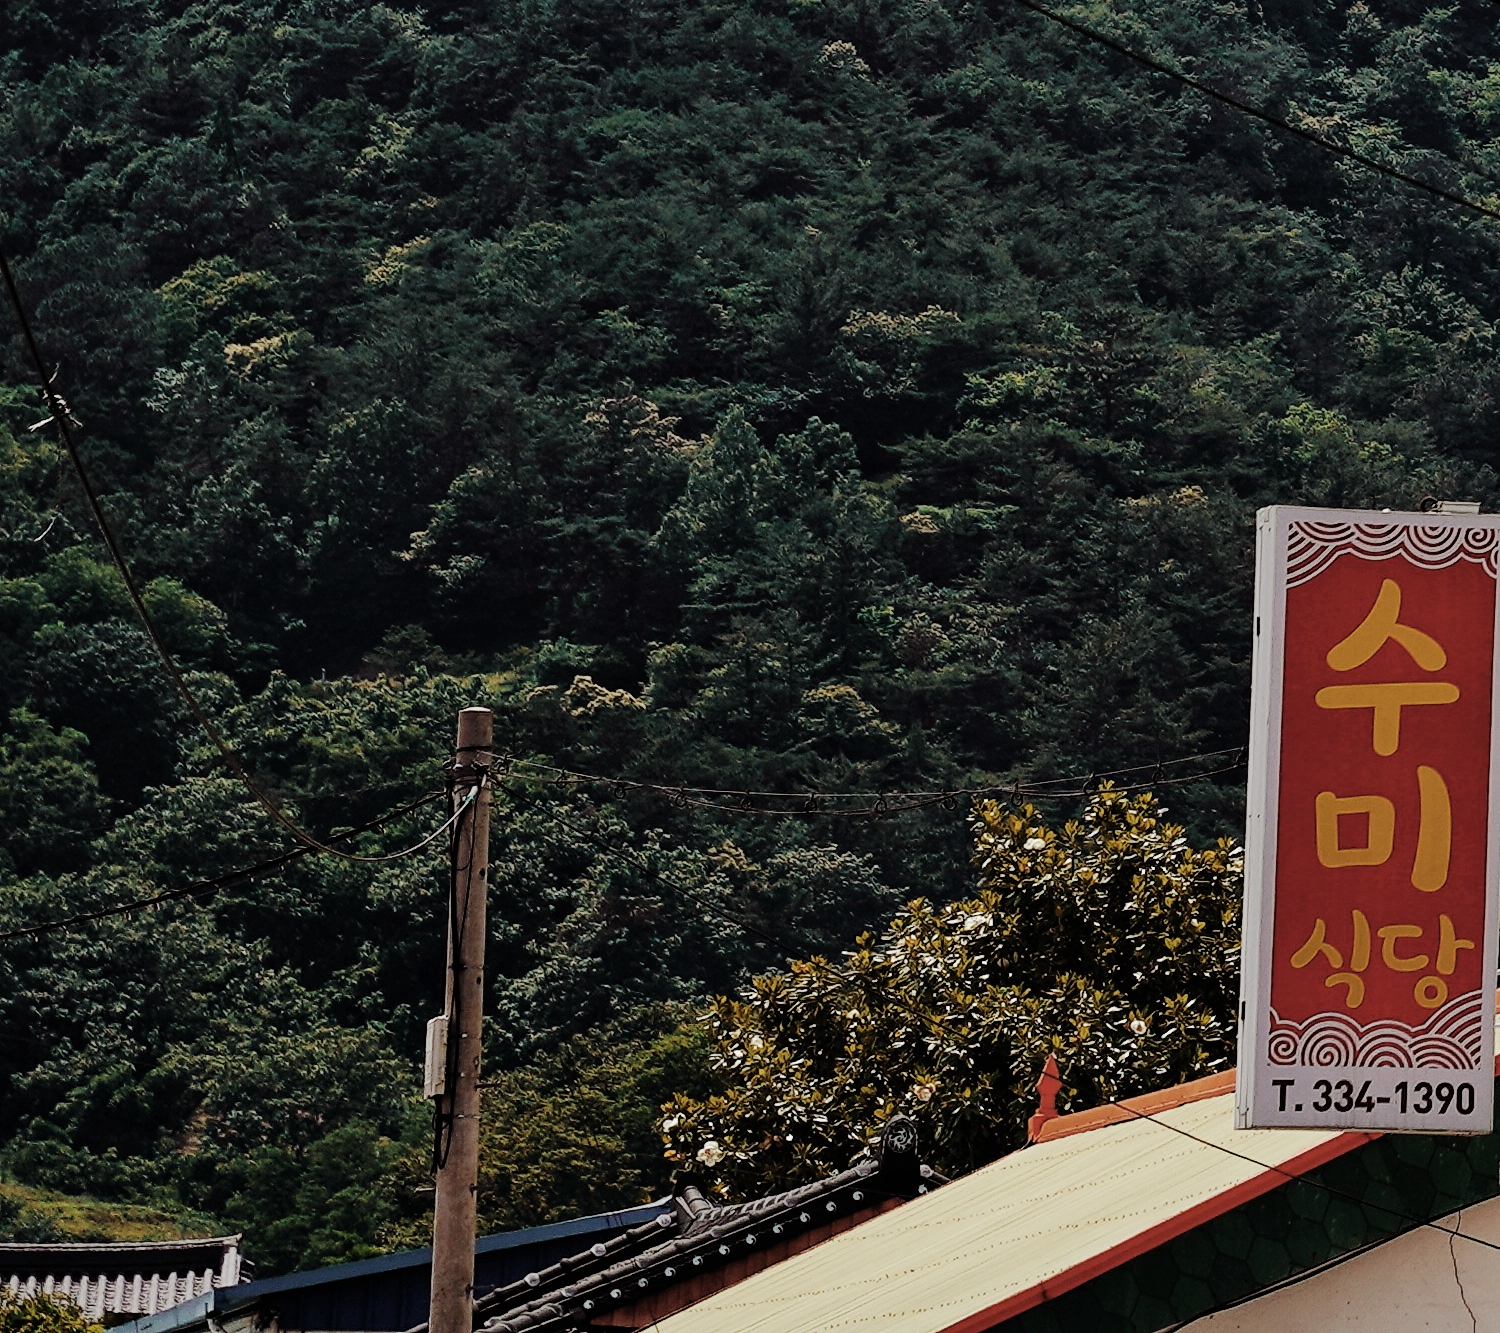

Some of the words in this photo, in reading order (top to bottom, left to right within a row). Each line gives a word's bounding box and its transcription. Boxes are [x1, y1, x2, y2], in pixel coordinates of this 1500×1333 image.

[1314, 577, 1460, 893] 수미
[1290, 908, 1476, 1010] 식당
[1312, 1079, 1476, 1116] 334-1390
